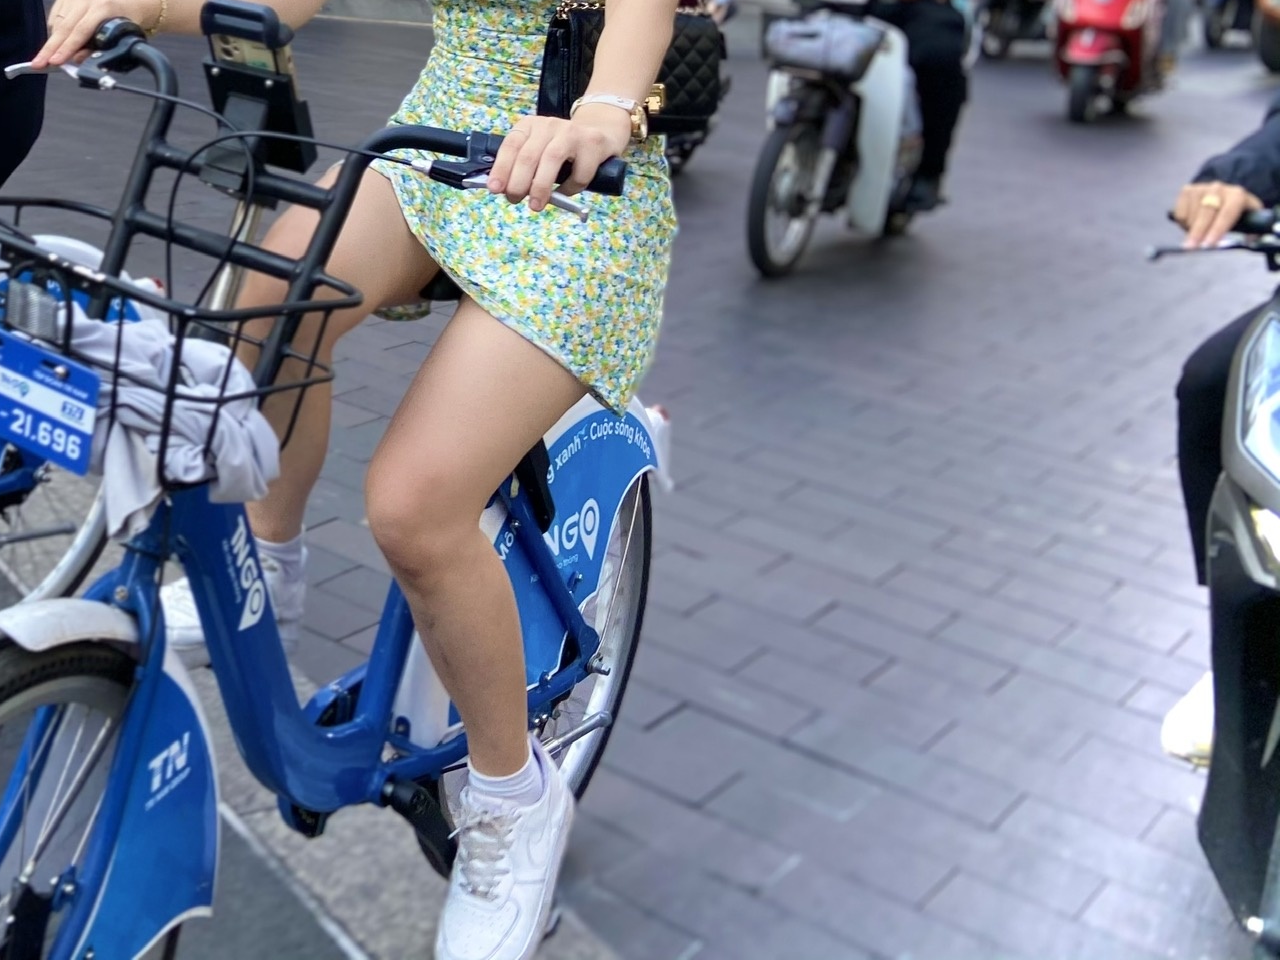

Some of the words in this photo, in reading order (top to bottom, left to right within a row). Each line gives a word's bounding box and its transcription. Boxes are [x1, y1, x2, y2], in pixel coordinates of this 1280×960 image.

[10, 408, 82, 461] 21.696
[554, 435, 582, 470] xanh
[590, 418, 613, 441] Cuộc
[615, 415, 634, 444] sống
[542, 498, 600, 561] NGO
[147, 731, 191, 794] TN
